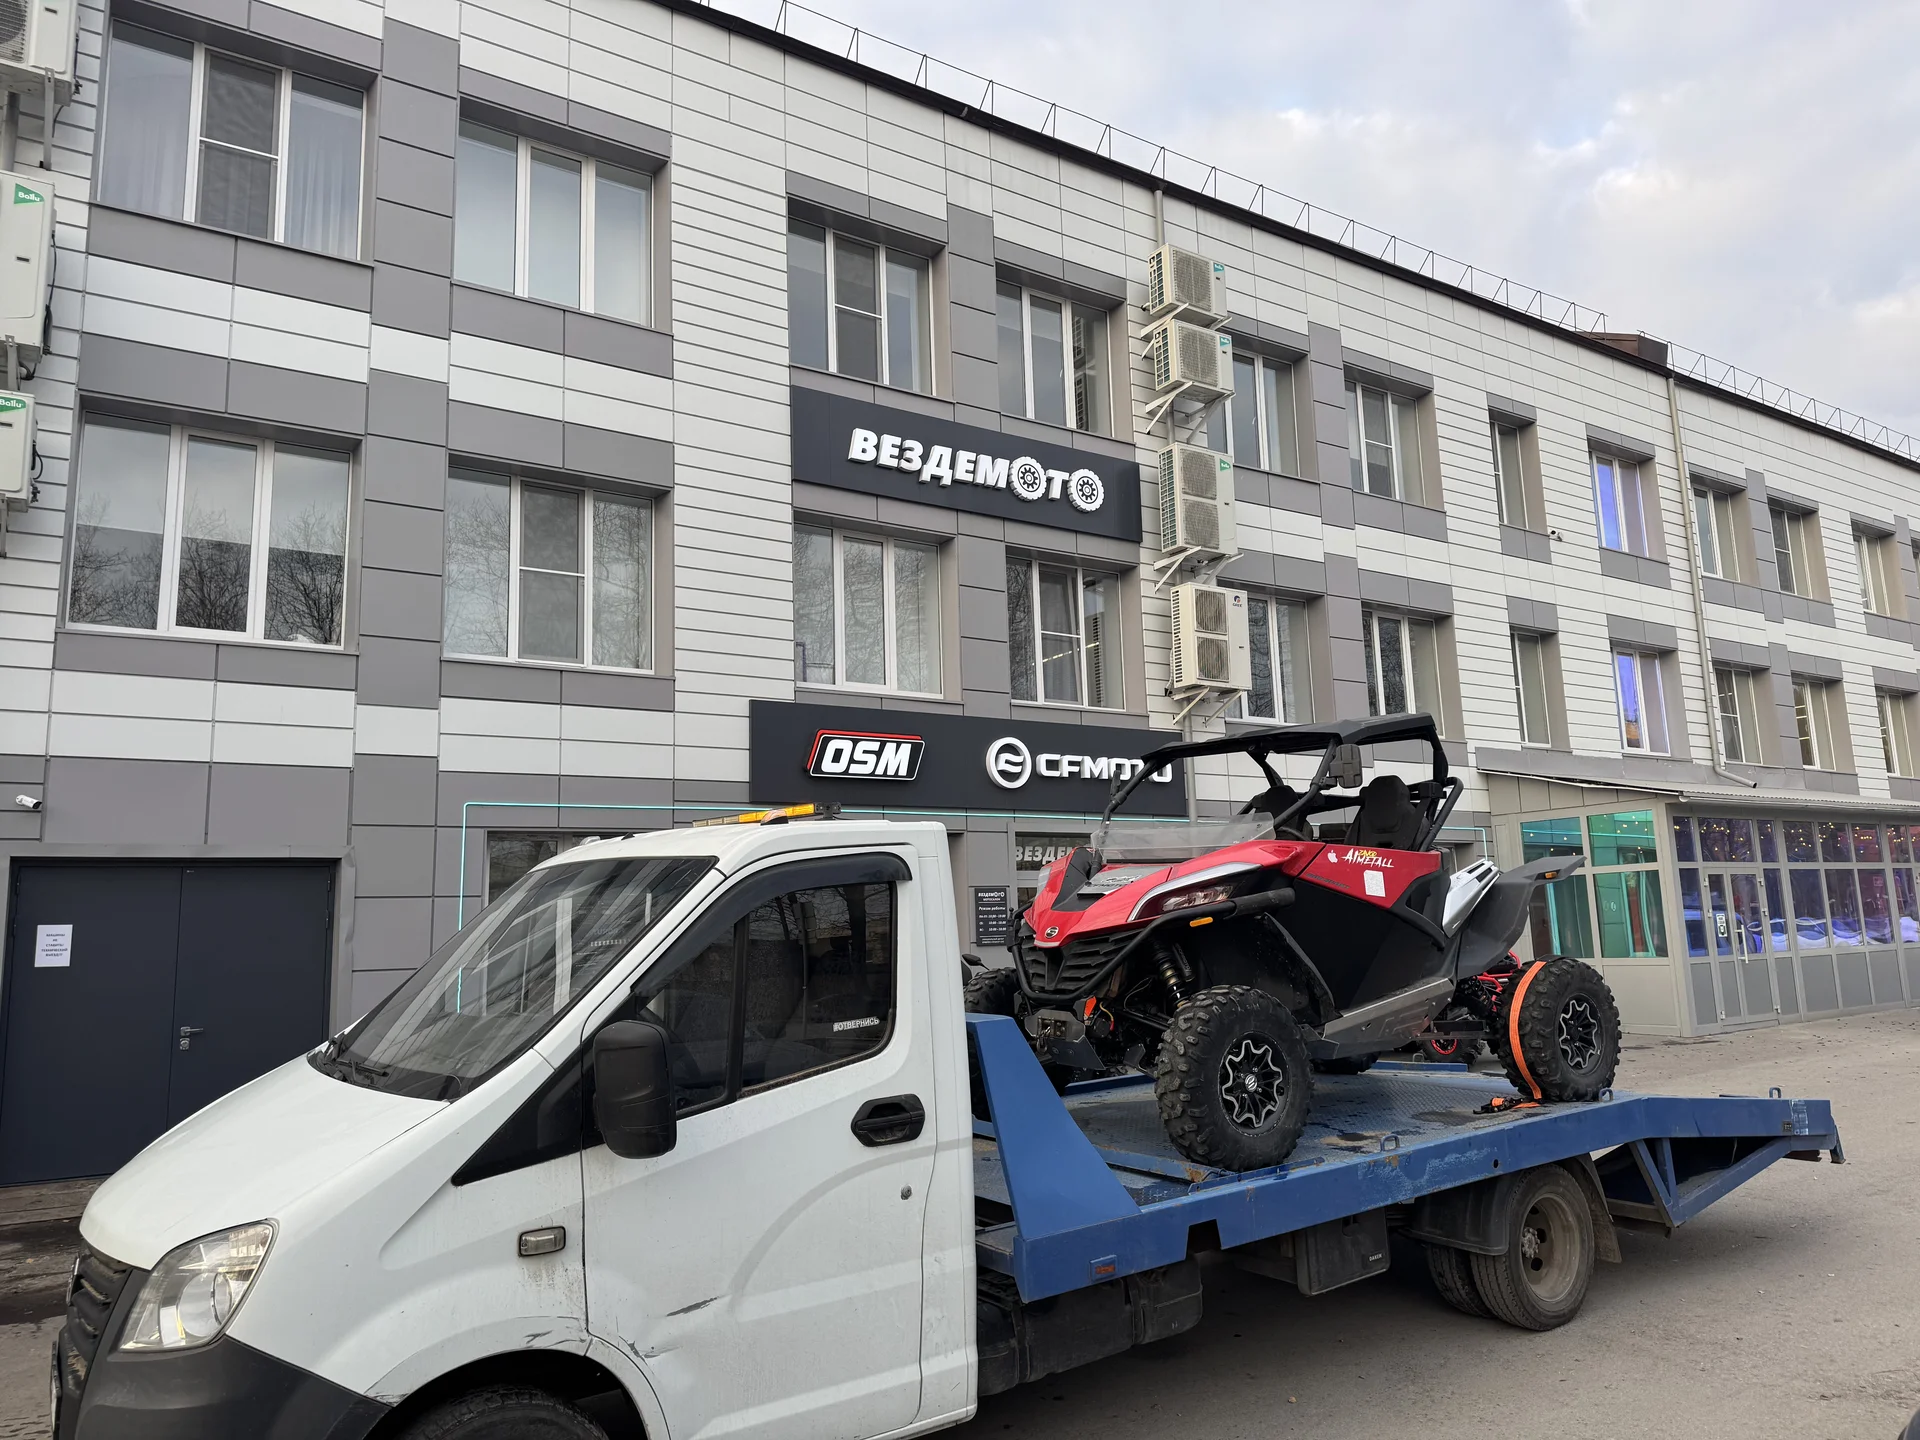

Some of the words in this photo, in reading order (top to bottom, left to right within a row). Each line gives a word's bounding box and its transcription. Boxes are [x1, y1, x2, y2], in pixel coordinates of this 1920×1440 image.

[18, 191, 40, 202] Ballu
[0, 398, 22, 408] Ballu
[847, 427, 1105, 514] ВЕЗДЕМОТО
[820, 738, 913, 777] OSM
[832, 1016, 880, 1032] #ОТВЕРНИСЬ
